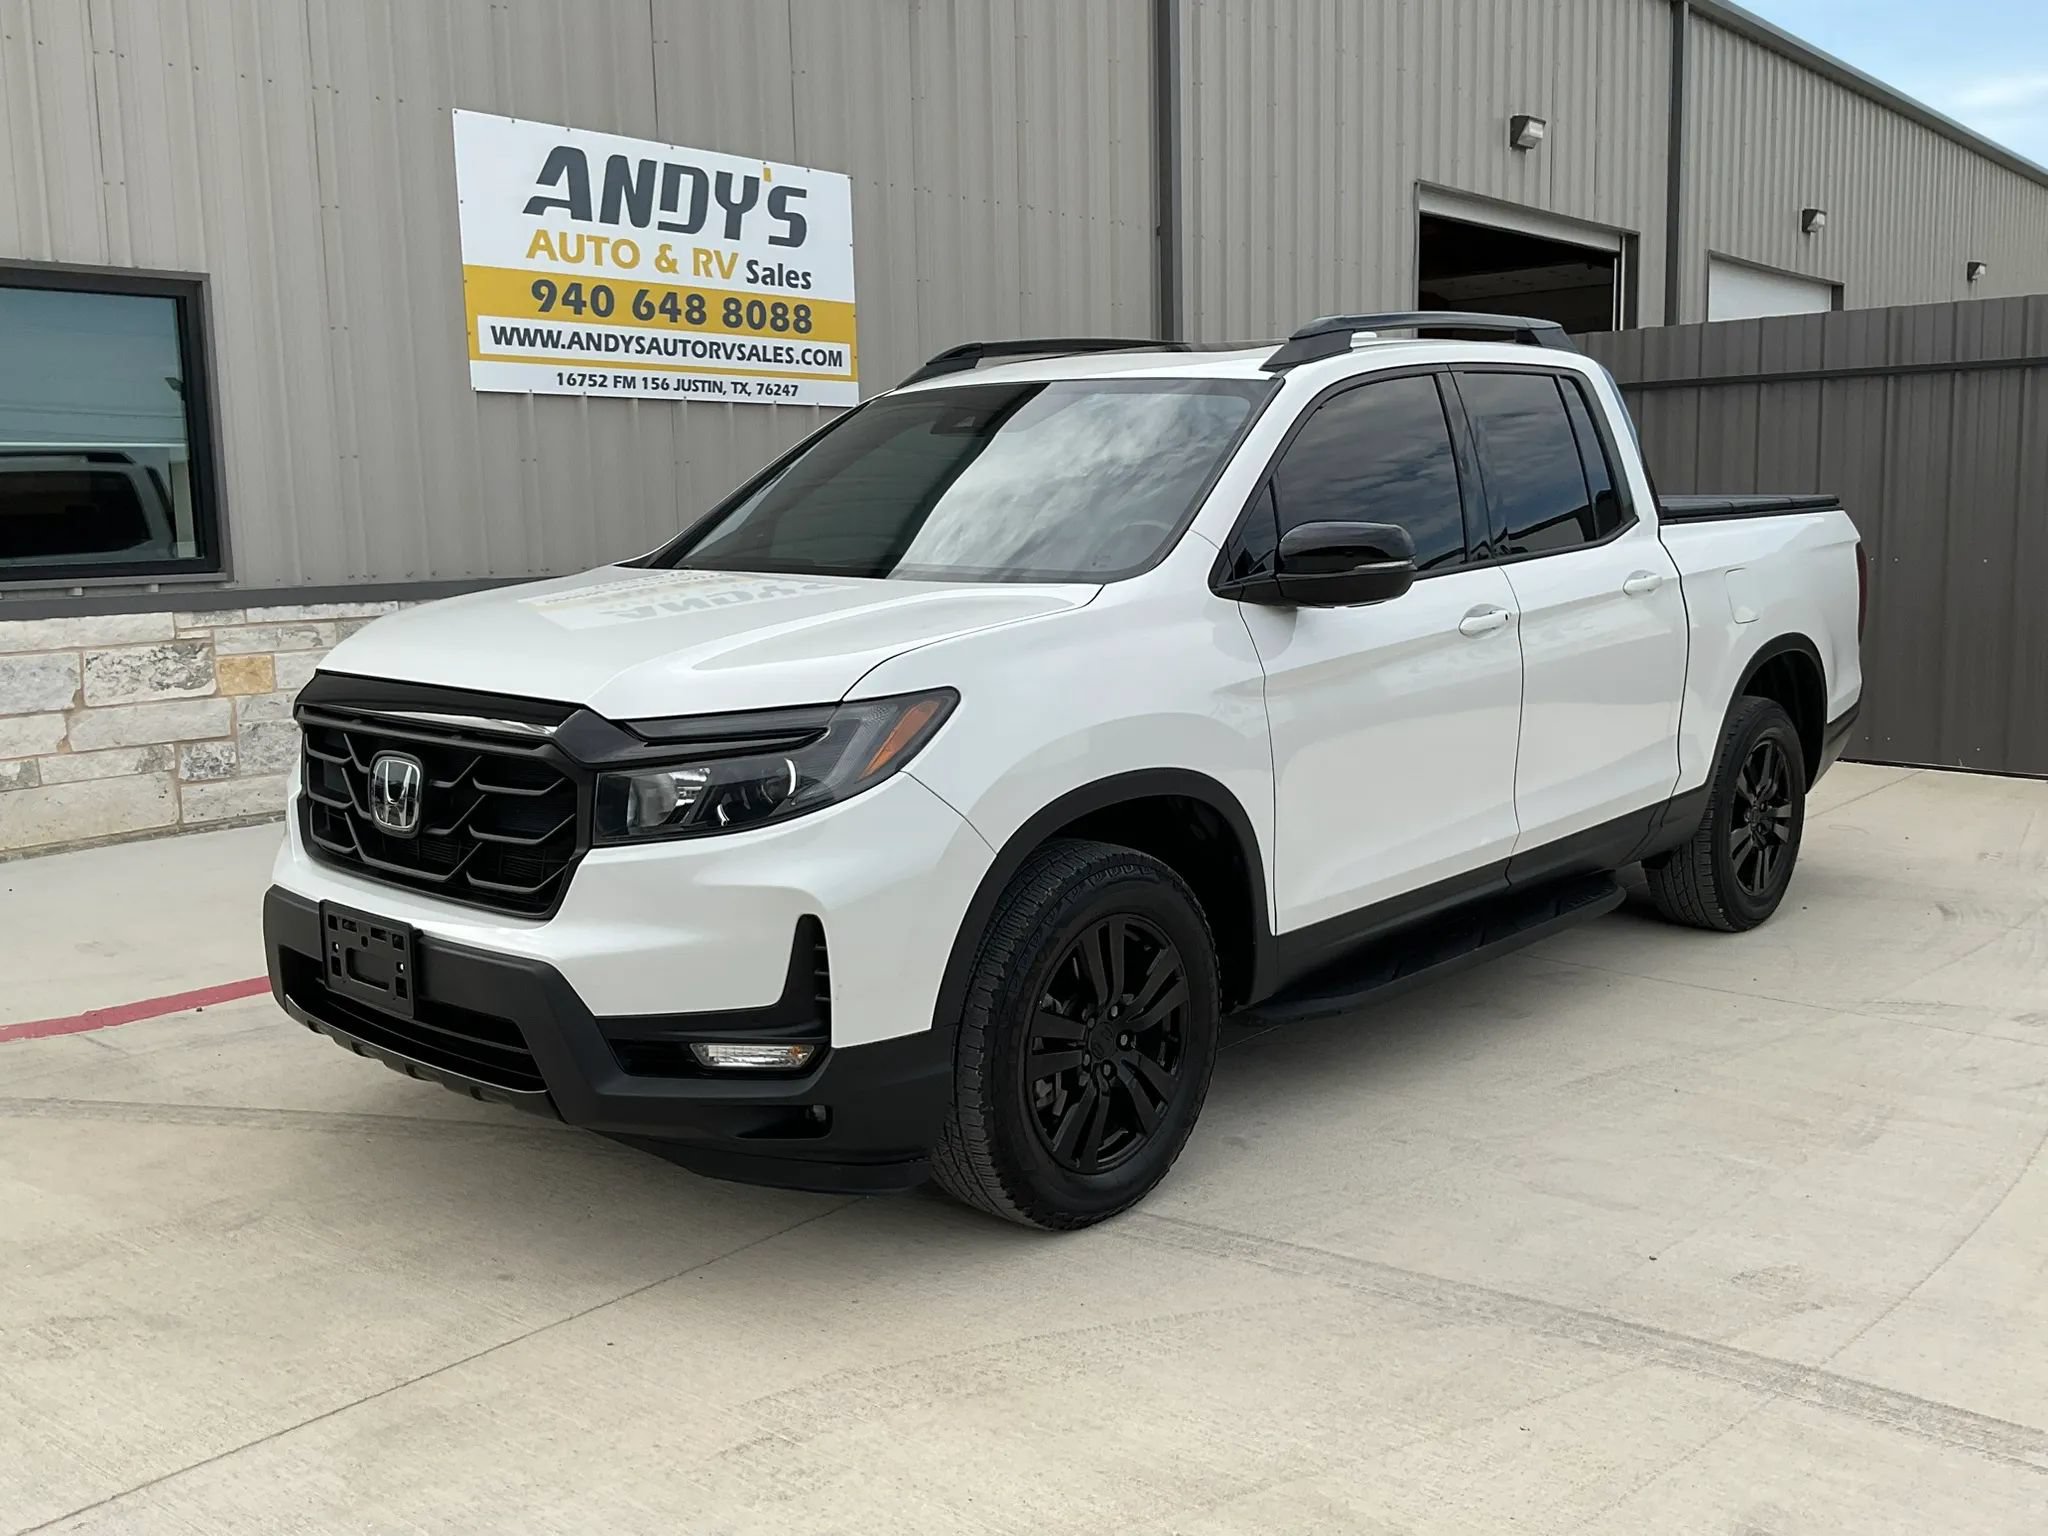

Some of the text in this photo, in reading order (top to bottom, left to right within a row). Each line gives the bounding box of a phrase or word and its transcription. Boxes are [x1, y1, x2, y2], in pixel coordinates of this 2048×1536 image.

[522, 146, 808, 248] ANDY'S
[526, 229, 812, 290] AUTO & RV Sales
[531, 279, 813, 335] 940 648 8088
[490, 325, 843, 368] WWW.ANDYSAUTORVSALES.COM
[556, 372, 799, 398] 16752 FM 156 JUSTIN, TX, 76247
